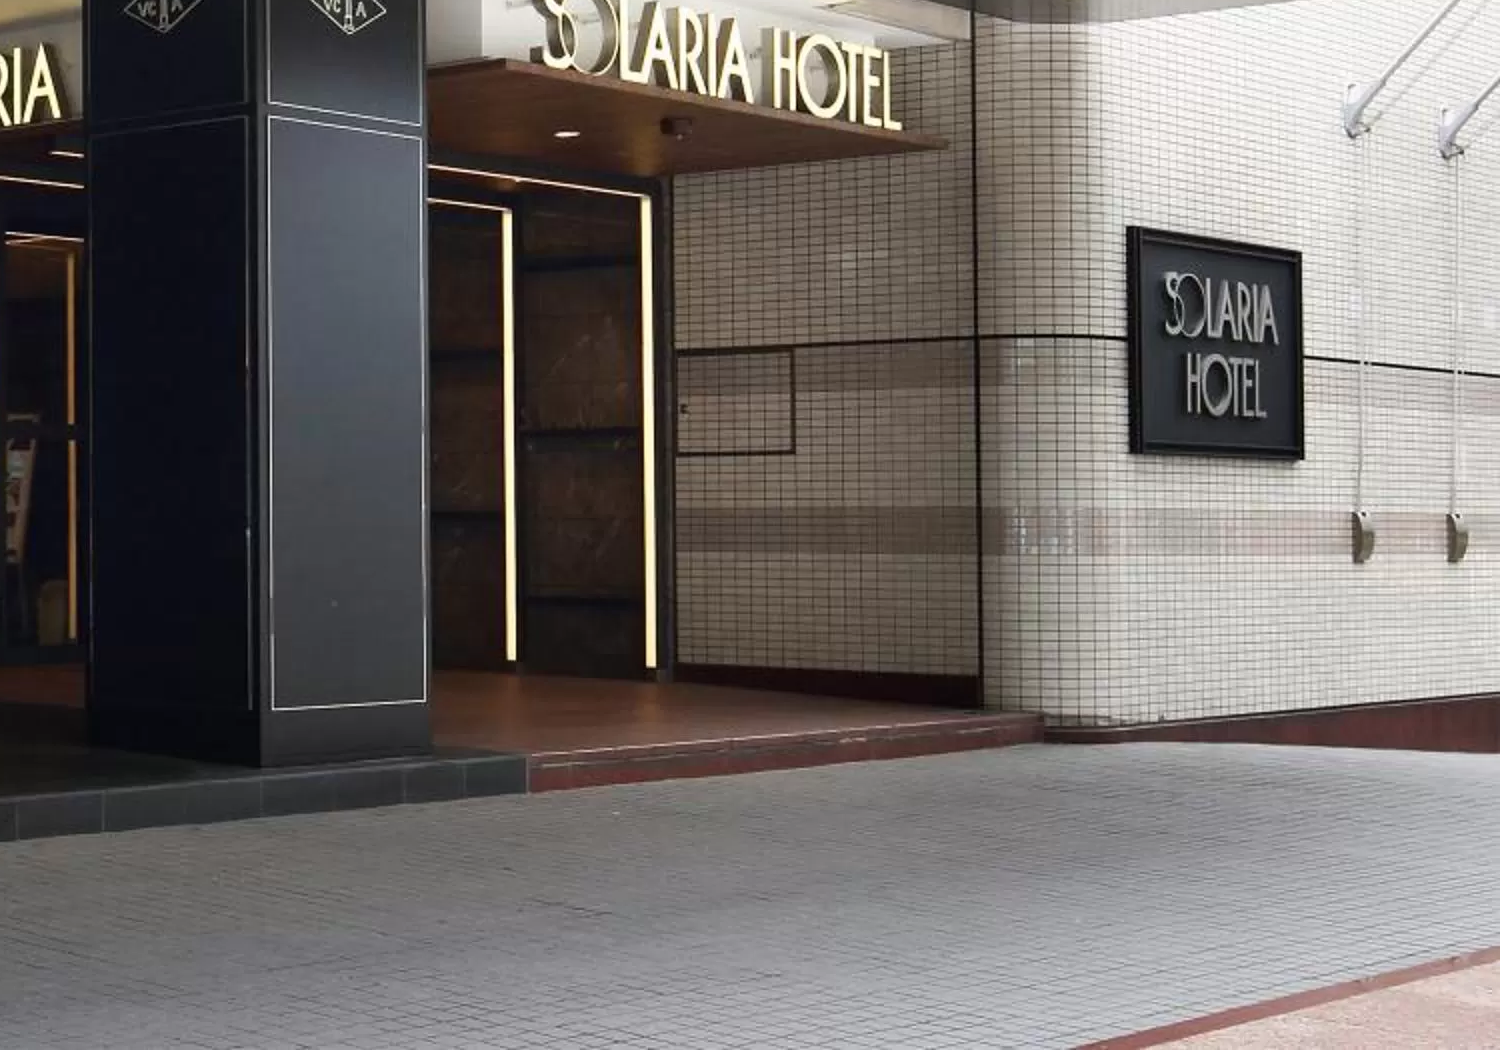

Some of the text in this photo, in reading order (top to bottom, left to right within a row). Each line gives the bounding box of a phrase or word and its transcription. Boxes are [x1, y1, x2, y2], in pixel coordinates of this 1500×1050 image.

[773, 26, 902, 131] HOTEL
[1163, 270, 1280, 346] SOLARIA
[1187, 351, 1268, 418] HOTEL
